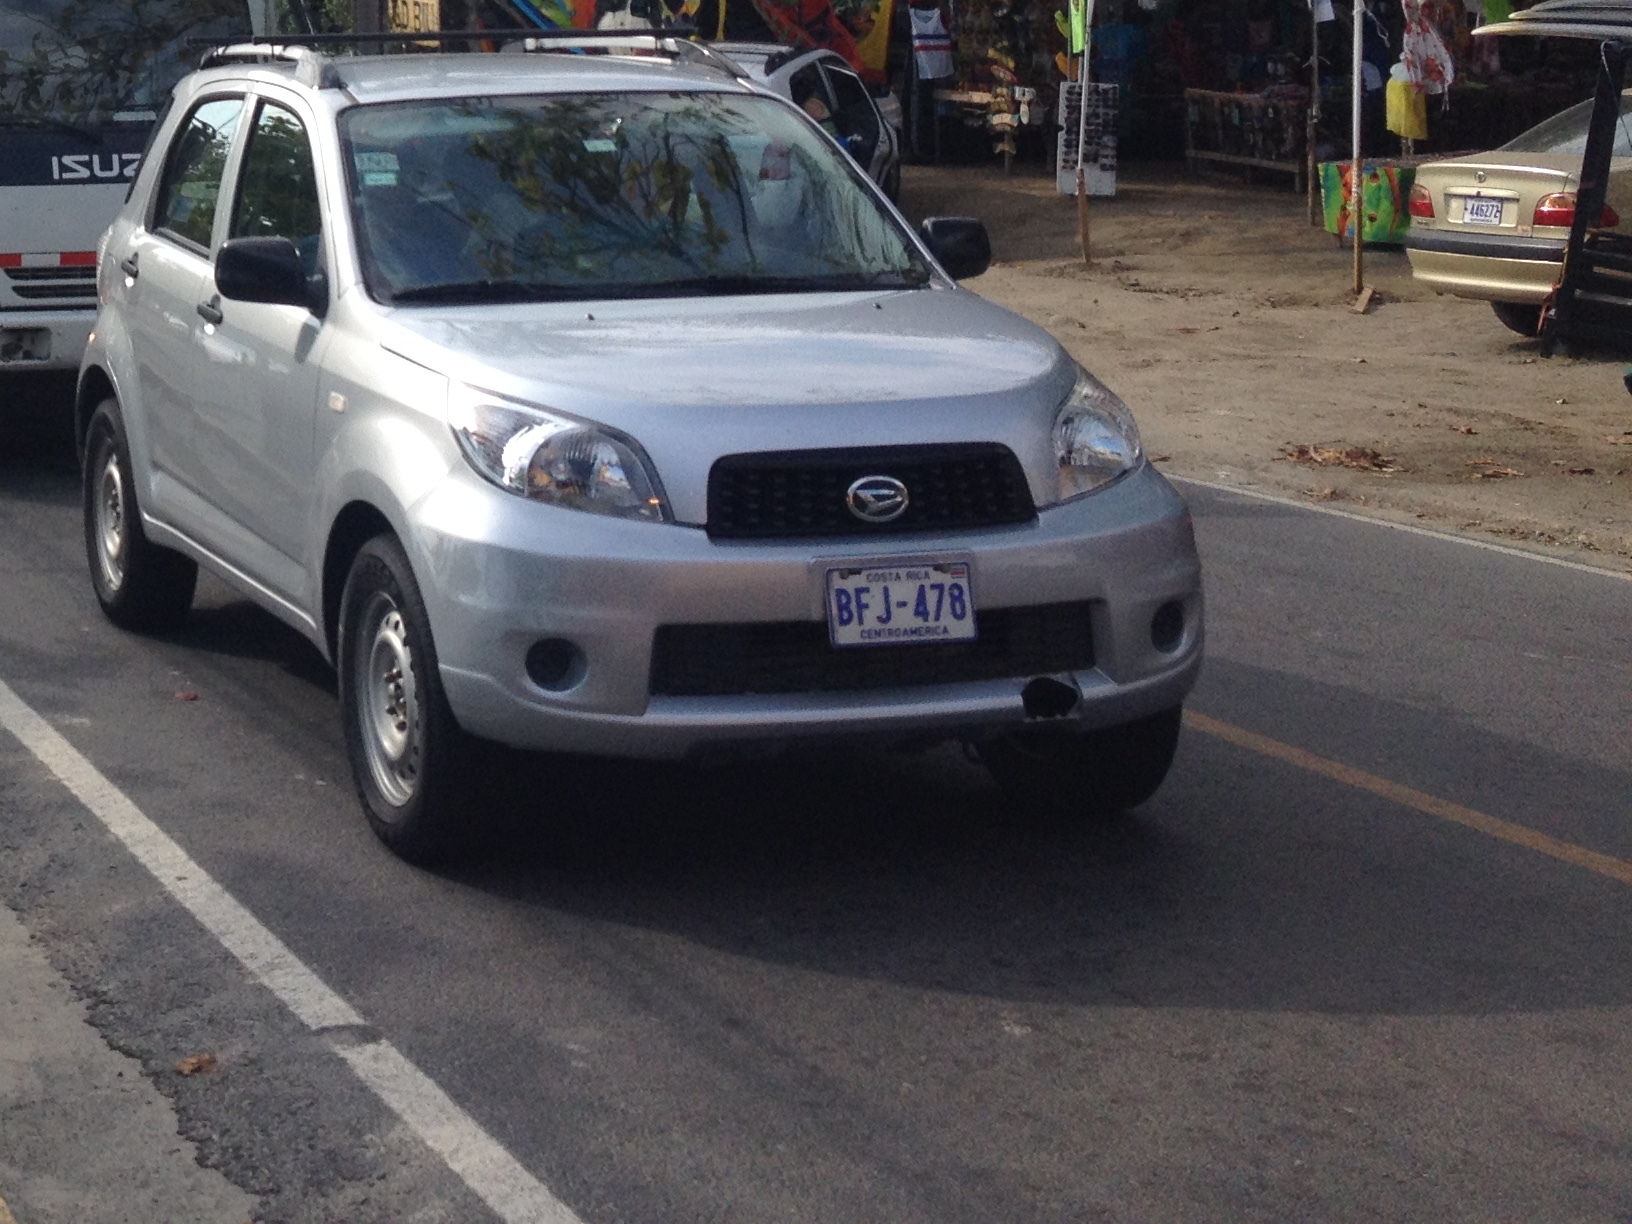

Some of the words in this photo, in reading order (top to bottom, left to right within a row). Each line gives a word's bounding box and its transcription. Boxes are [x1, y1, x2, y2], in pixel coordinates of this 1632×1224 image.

[867, 572, 902, 583] COSTA
[906, 570, 931, 581] RICA
[835, 582, 967, 627] BFJ-478
[860, 626, 950, 639] CENTROAMERICA
